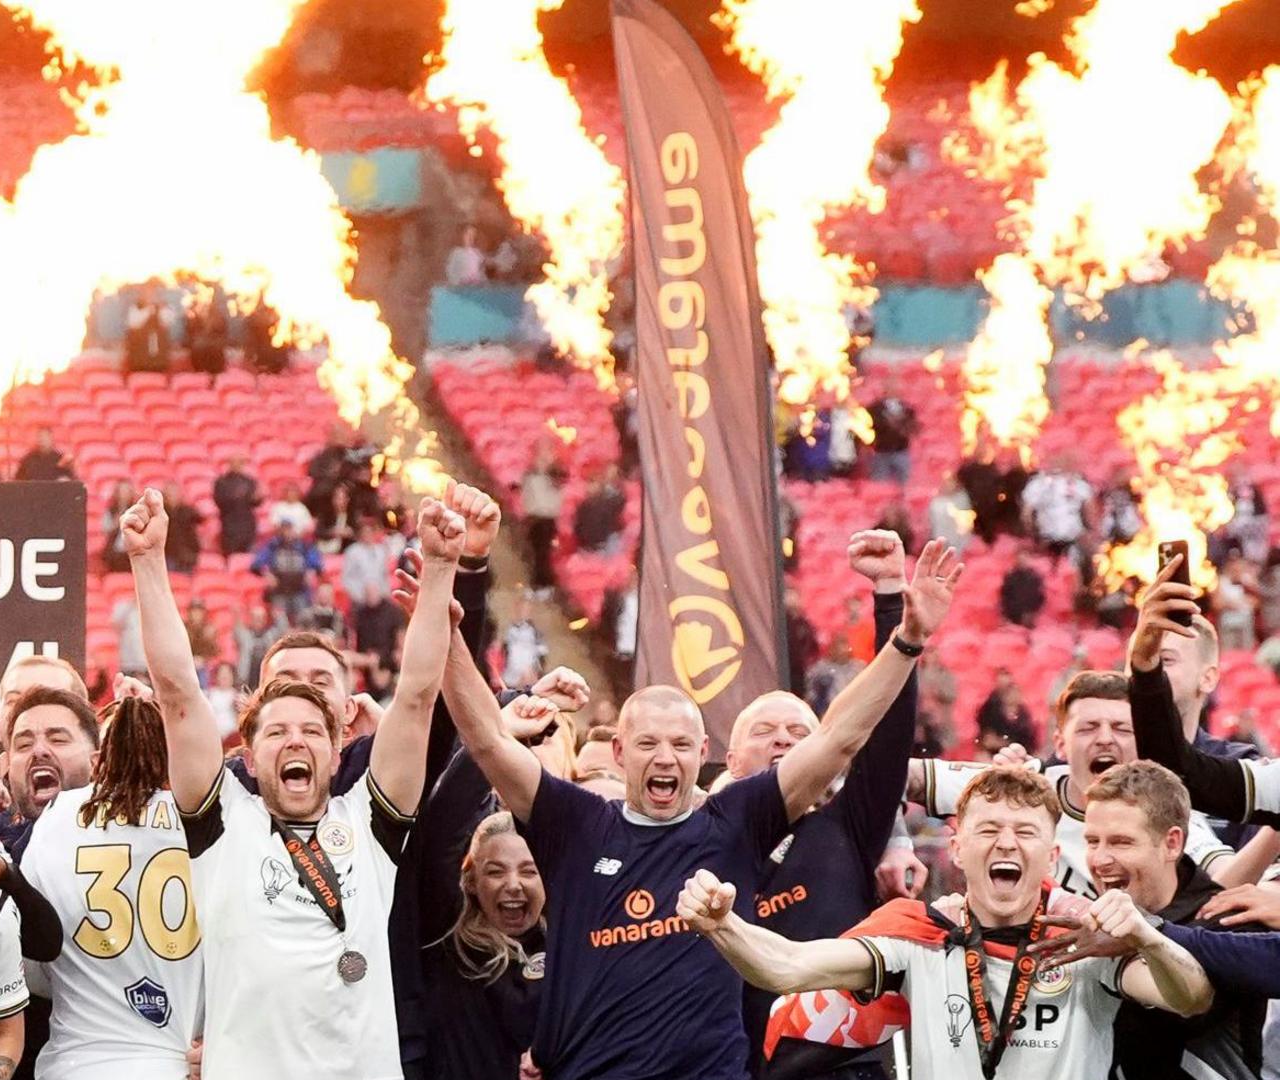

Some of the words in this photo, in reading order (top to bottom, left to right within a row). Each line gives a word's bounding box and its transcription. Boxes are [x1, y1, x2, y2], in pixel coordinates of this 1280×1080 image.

[294, 848, 338, 908] vanarama
[1061, 866, 1099, 902] LS
[72, 843, 202, 961] 30
[591, 914, 690, 948] vanaram
[134, 989, 166, 1006] blue
[968, 968, 993, 1044] vanarama
[1008, 972, 1030, 1024] vana
[1012, 1003, 1060, 1032] SP
[1008, 1039, 1060, 1049] WABLES
